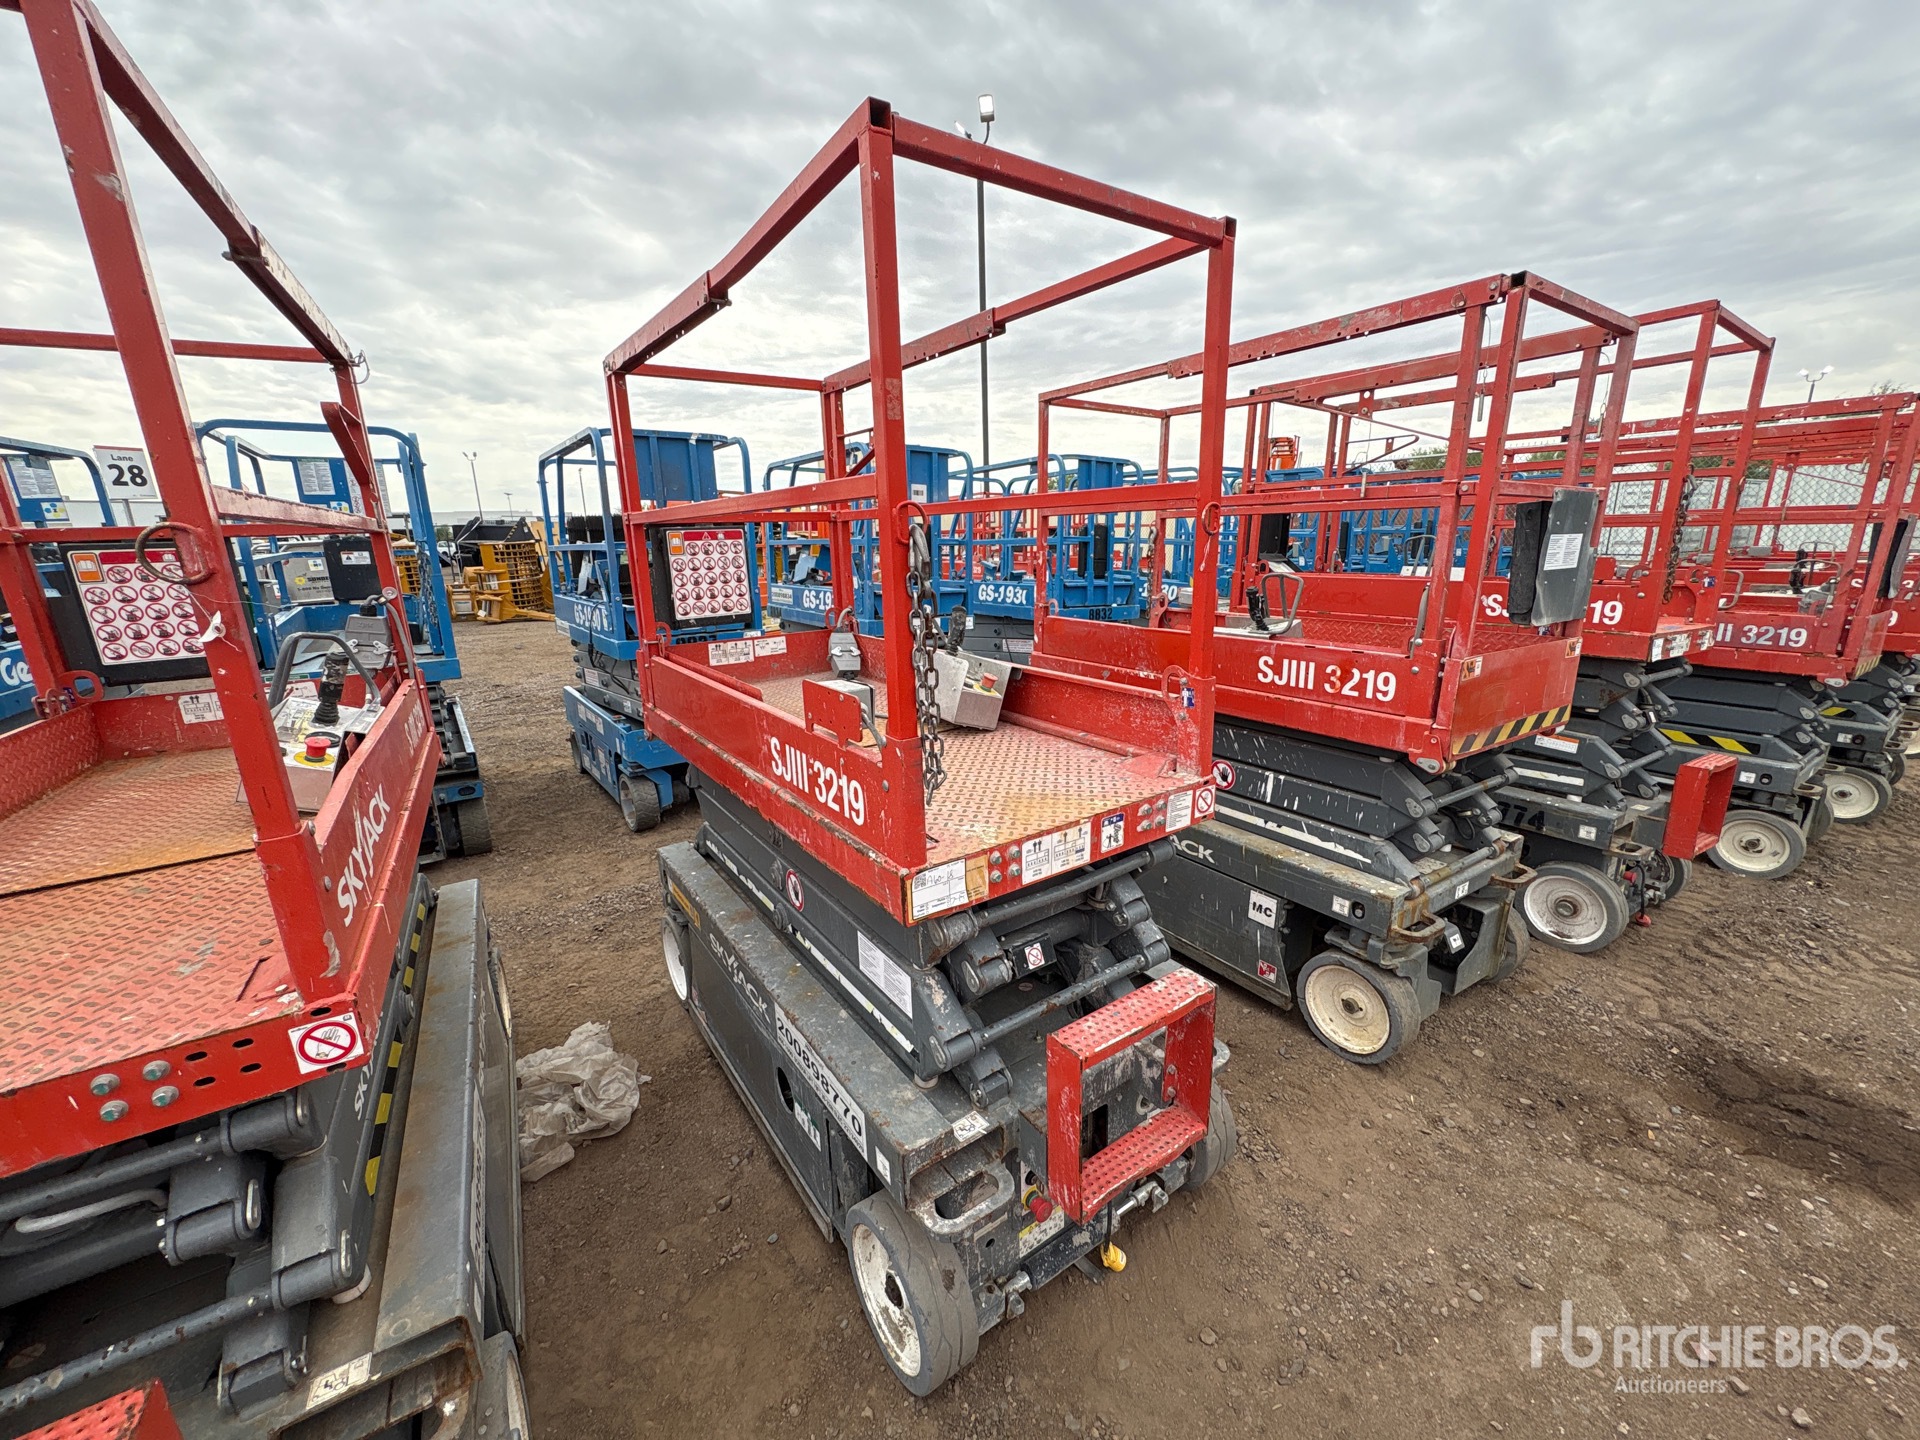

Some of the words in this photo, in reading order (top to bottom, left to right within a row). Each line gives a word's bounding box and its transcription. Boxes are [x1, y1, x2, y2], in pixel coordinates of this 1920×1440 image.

[110, 453, 134, 462] Lane
[107, 463, 148, 487] 28
[803, 589, 834, 610] GS-19
[1089, 607, 1113, 621] 8832
[1740, 625, 1808, 648] 3219
[1257, 655, 1316, 690] SJIII
[1323, 664, 1397, 702] 3219
[770, 737, 809, 794] SJIII
[813, 760, 865, 826] 3219
[337, 783, 391, 928] SKYJACK
[1252, 901, 1274, 918] MC
[777, 1016, 862, 1137] 200898770
